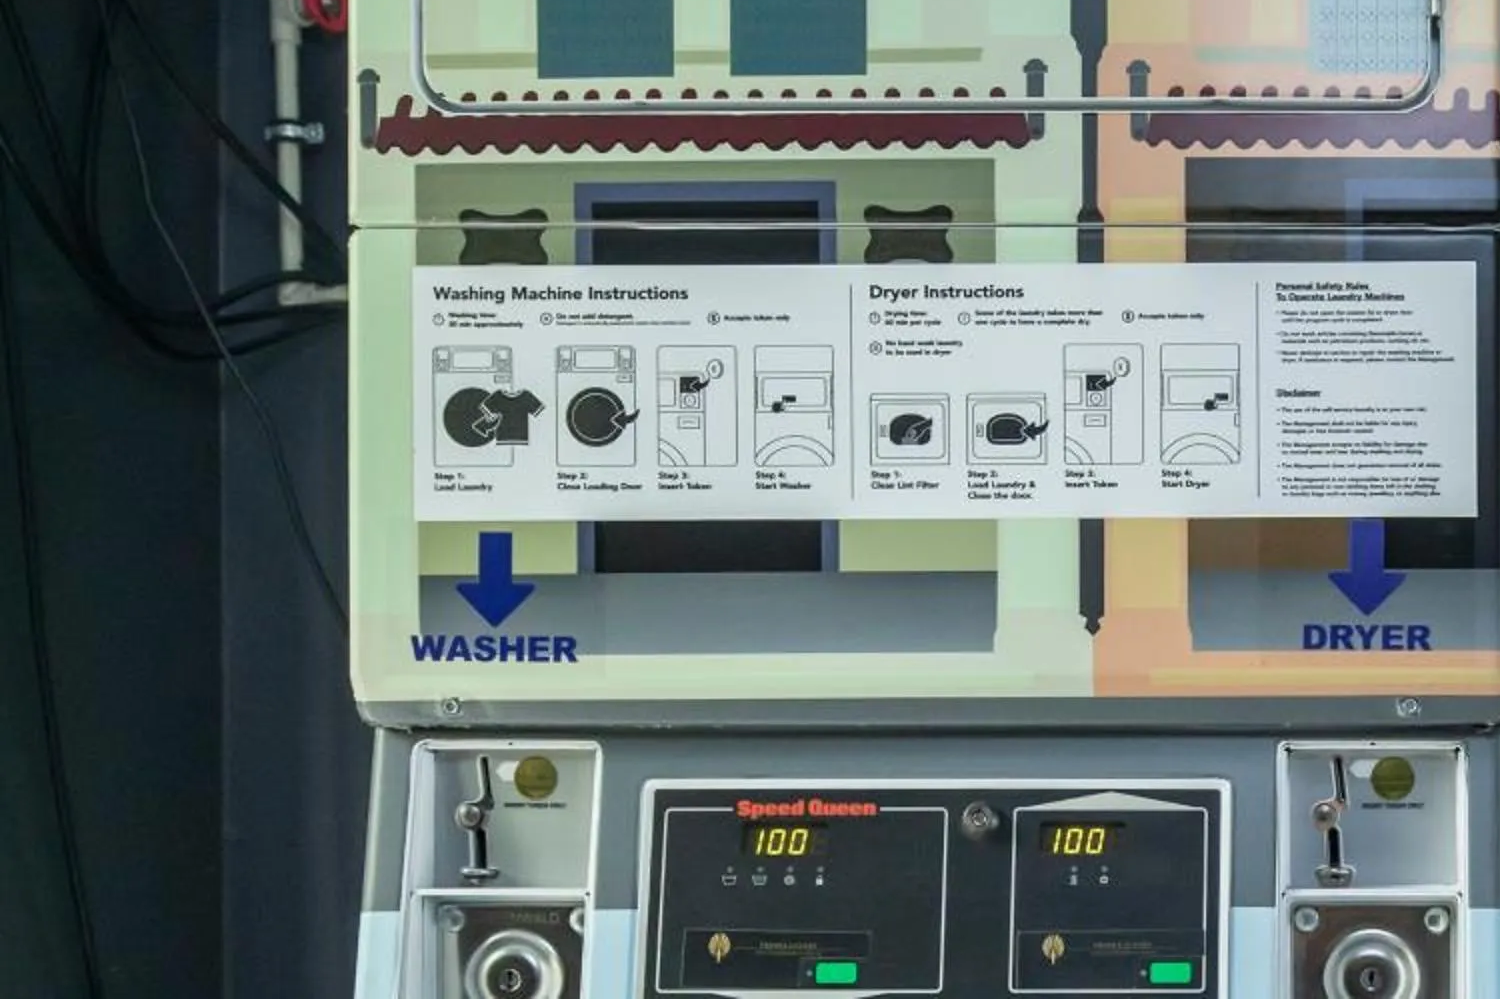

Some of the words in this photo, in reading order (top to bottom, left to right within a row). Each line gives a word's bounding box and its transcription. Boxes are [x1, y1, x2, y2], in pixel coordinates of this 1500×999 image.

[1276, 282, 1313, 291] Personal
[1316, 282, 1343, 292] Safety
[1345, 282, 1369, 291] Rules
[433, 286, 505, 304] Washing
[511, 286, 583, 300] Machine
[589, 286, 689, 300] Instructions
[870, 284, 919, 303] Dryer
[923, 284, 1024, 299] Instructions
[1276, 293, 1286, 302] To
[1288, 293, 1325, 302] Operate
[1327, 293, 1362, 303] Laundry
[1364, 293, 1405, 302] Machines
[434, 472, 455, 481] Step
[557, 472, 577, 481] Step
[657, 471, 678, 480] Step
[755, 471, 776, 480] Step
[871, 470, 890, 479] Step
[967, 470, 988, 479] Step
[1065, 470, 1084, 478] Step
[1162, 469, 1182, 478] Step
[434, 482, 455, 492] Load
[458, 482, 493, 492] Laundry
[557, 482, 581, 492] Close
[583, 482, 619, 492] Loading
[620, 482, 643, 492] Door
[658, 482, 683, 490] Insert
[686, 482, 712, 490] Token
[755, 482, 777, 490] Start
[779, 482, 811, 490] Washer
[967, 481, 989, 490] Load
[992, 481, 1026, 490] Laundry
[1065, 480, 1090, 488] Insert
[1093, 480, 1119, 488] Token
[1162, 480, 1183, 489] Start
[1185, 480, 1210, 489] Dryer
[994, 491, 1008, 500] the
[1303, 624, 1432, 651] DRYER
[411, 635, 578, 663] WASHER
[737, 800, 805, 818] Speed
[808, 800, 877, 817] Queen
[755, 828, 808, 855] 100
[1053, 828, 1105, 854] 100
